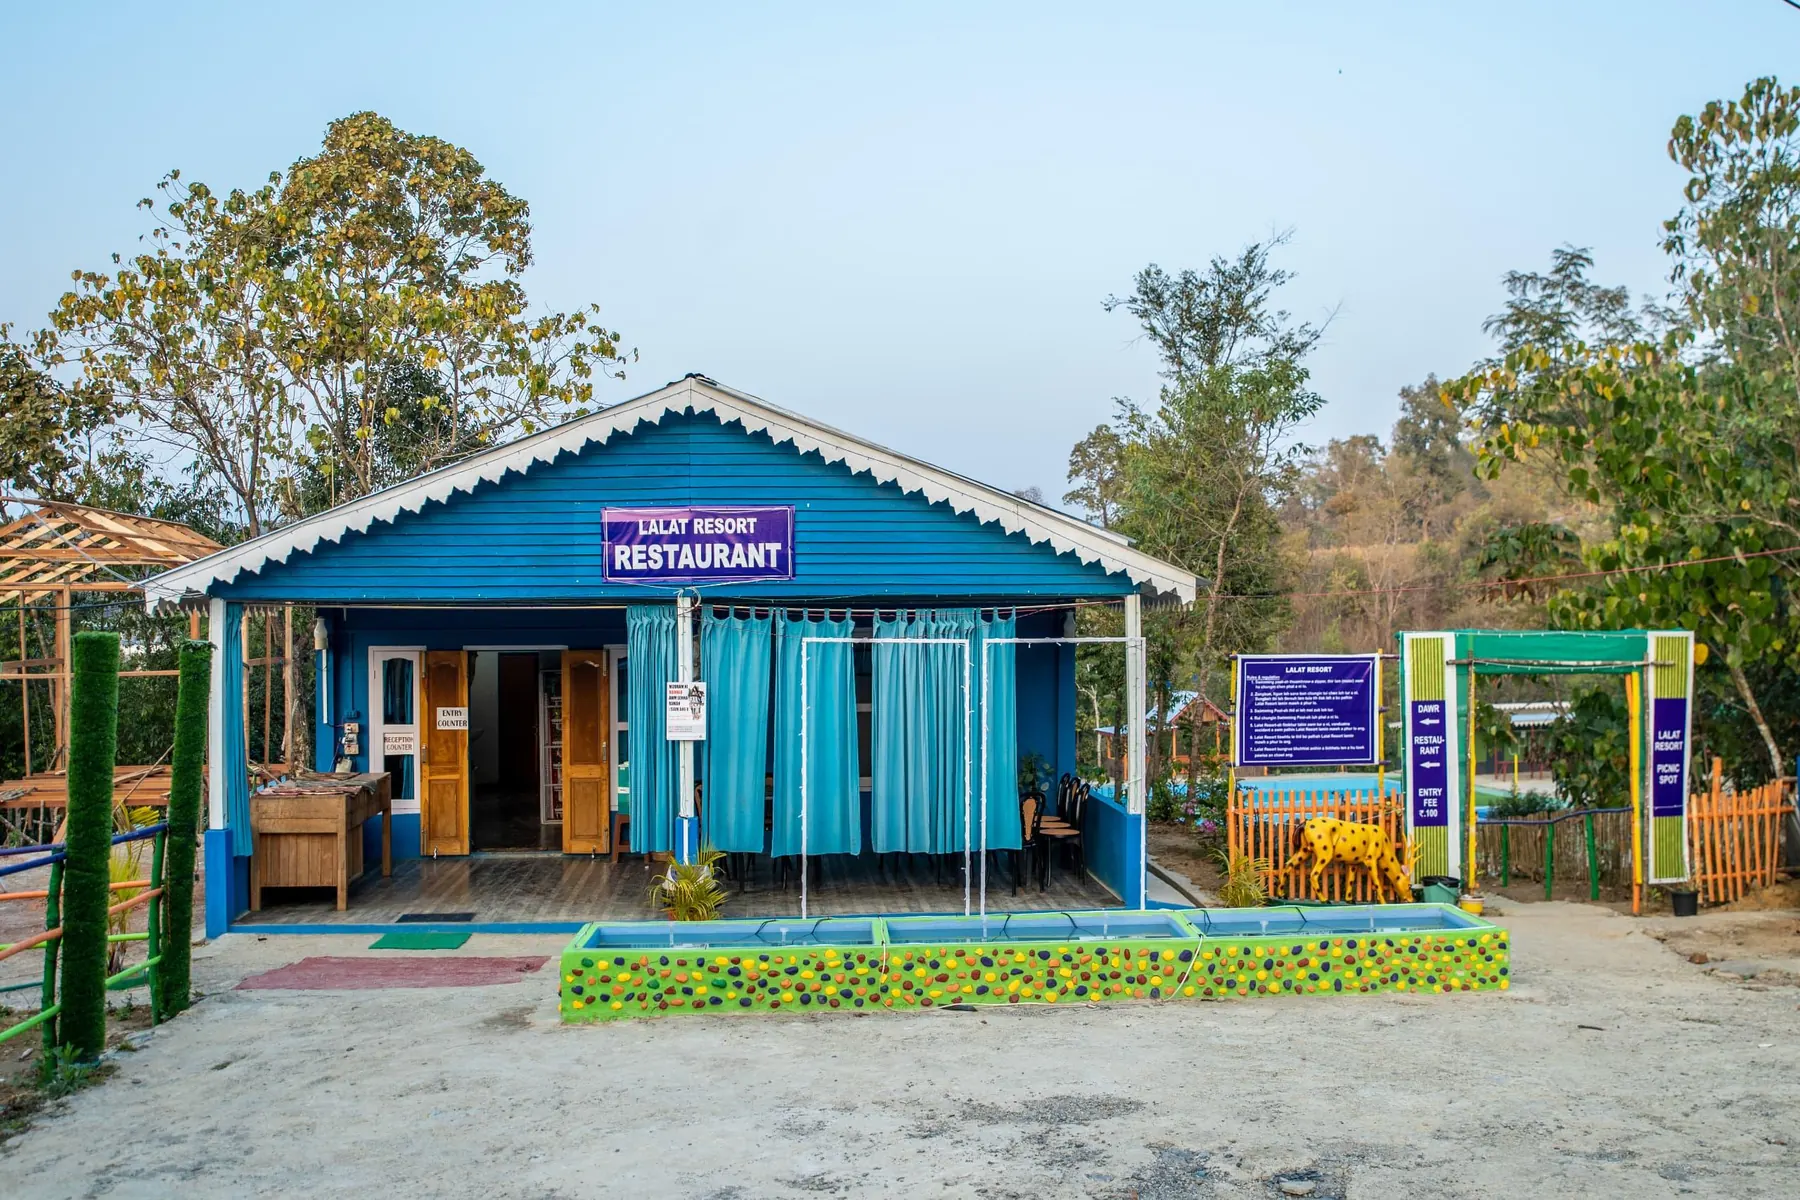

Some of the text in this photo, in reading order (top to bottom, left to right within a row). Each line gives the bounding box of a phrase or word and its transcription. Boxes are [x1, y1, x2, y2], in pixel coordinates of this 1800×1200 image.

[638, 518, 757, 535] LALAT RESORT
[614, 542, 782, 570] RESTAURANT
[1418, 705, 1440, 713] DAWR
[1658, 730, 1681, 740] LALAT
[1414, 736, 1445, 745] RESTAU-
[1420, 746, 1440, 754] RANT
[1654, 741, 1683, 751] RESORT
[1657, 764, 1680, 773] PICNIC
[1659, 775, 1678, 784] SPOT
[1418, 788, 1442, 797] ENTRY
